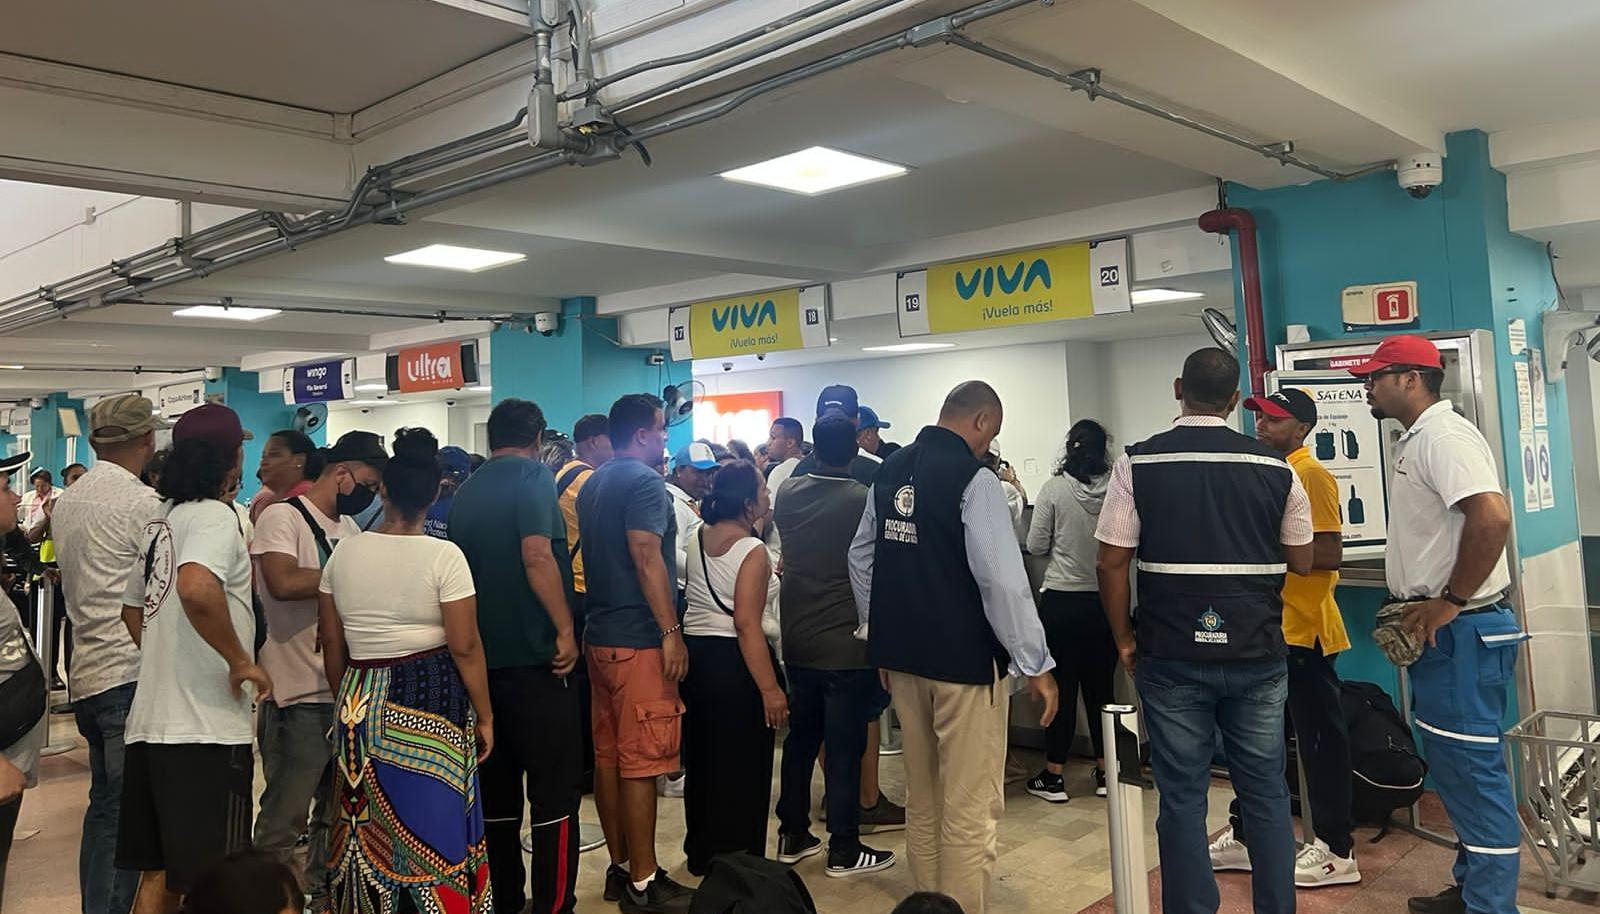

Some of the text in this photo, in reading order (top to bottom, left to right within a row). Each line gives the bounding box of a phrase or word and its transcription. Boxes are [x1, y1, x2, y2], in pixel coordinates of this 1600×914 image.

[955, 258, 1051, 300] VIVA
[1101, 269, 1118, 284] 20
[906, 297, 919, 310] 19
[983, 298, 1053, 320] ¡Vuela más!
[711, 300, 777, 332] VIVA
[807, 311, 817, 322] 18
[675, 328, 684, 340] 17
[407, 352, 452, 382] ultra
[1330, 359, 1360, 368] GABINETE
[306, 367, 327, 379] wingo
[1317, 389, 1363, 401] SATENA
